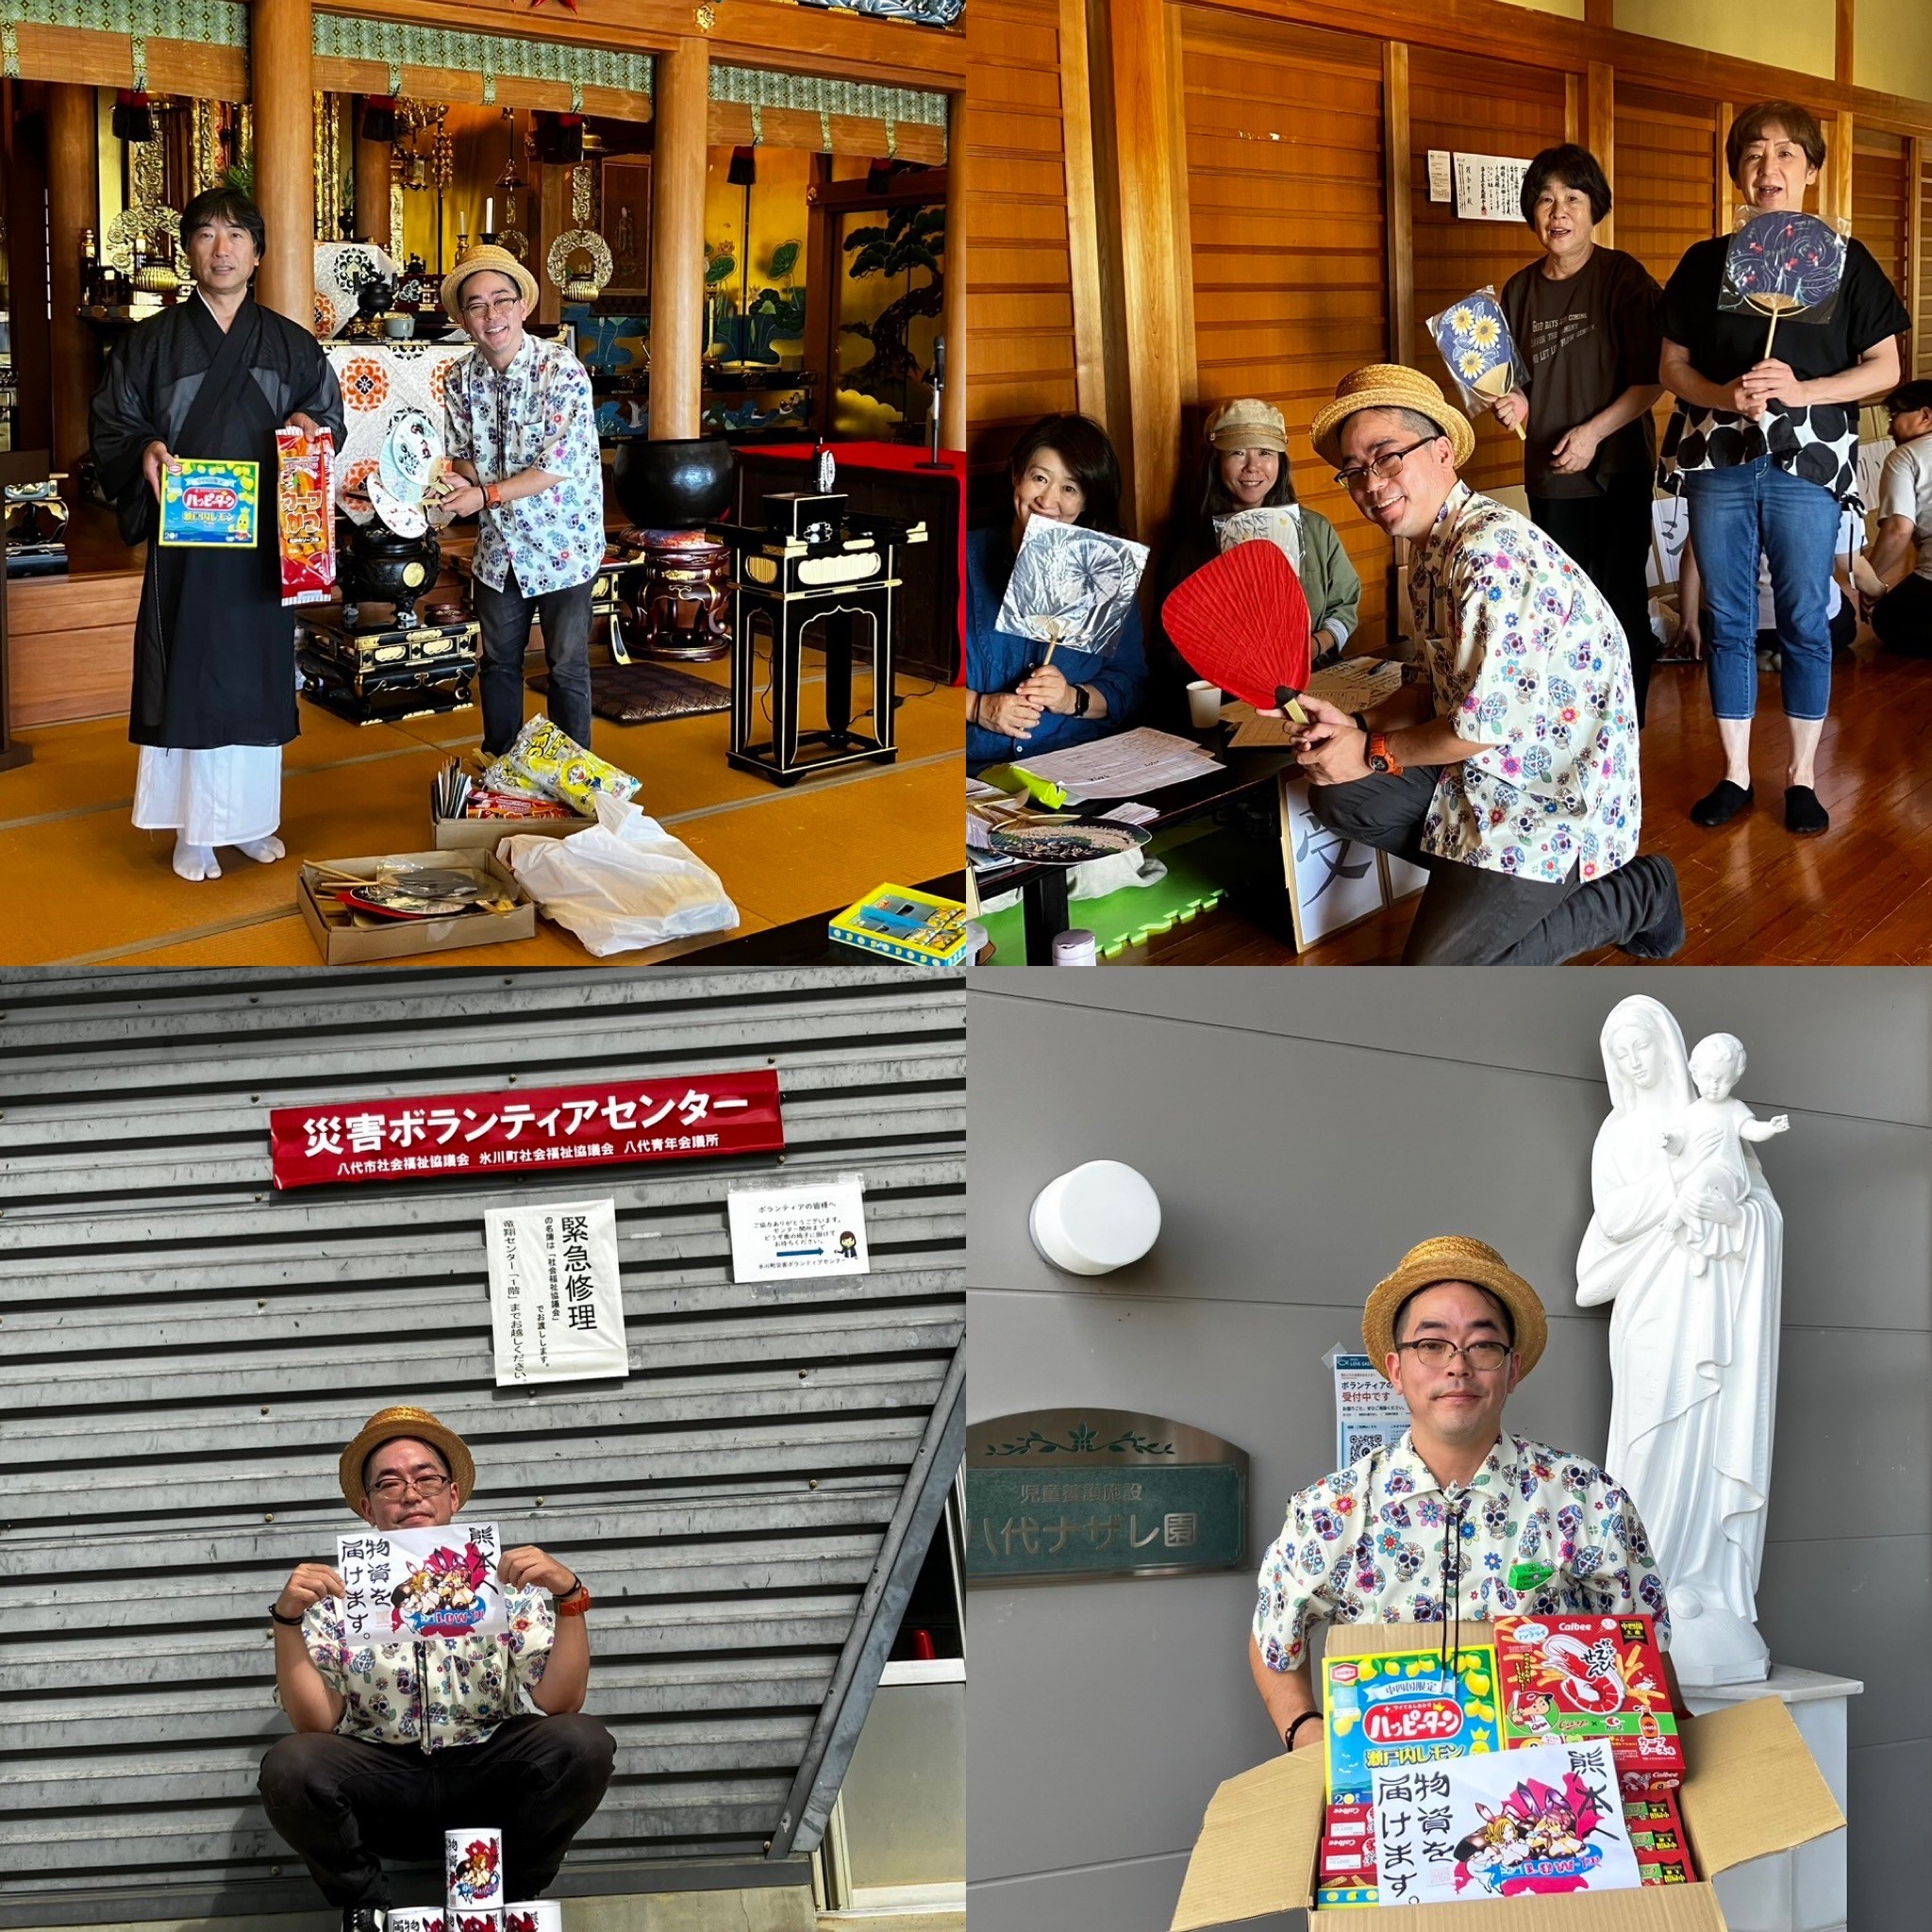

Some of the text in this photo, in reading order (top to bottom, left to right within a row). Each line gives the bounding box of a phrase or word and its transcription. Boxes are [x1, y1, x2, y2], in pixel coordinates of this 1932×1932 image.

[186, 491, 235, 508] ハッピーターン
[302, 1088, 750, 1158] 災害ボランティアセンター
[337, 1133, 720, 1176] 八代市社会福祉協議会 氷川町社会福祉協議会 八代青年会議所
[758, 1201, 837, 1214] ボランティアの皆様へ
[774, 1239, 824, 1248] お待ちください。
[561, 1215, 598, 1331] 緊急修理
[1341, 1391, 1391, 1403] 受付中です
[1020, 1482, 1143, 1505] 児童養護施設
[966, 1512, 1199, 1557] 八代ナザレ園
[365, 1538, 392, 1607] 物資を
[341, 1539, 371, 1641] 届けます。
[1558, 1623, 1592, 1631] Calbee
[1385, 1681, 1438, 1695] 中四国限定
[1369, 1709, 1459, 1739] ハッピーターン
[1639, 1738, 1666, 1747] カープ
[1365, 1745, 1463, 1768] 瀬戸内レモン
[1413, 1771, 1455, 1864] 物資を
[1378, 1773, 1420, 1905] 届けます。
